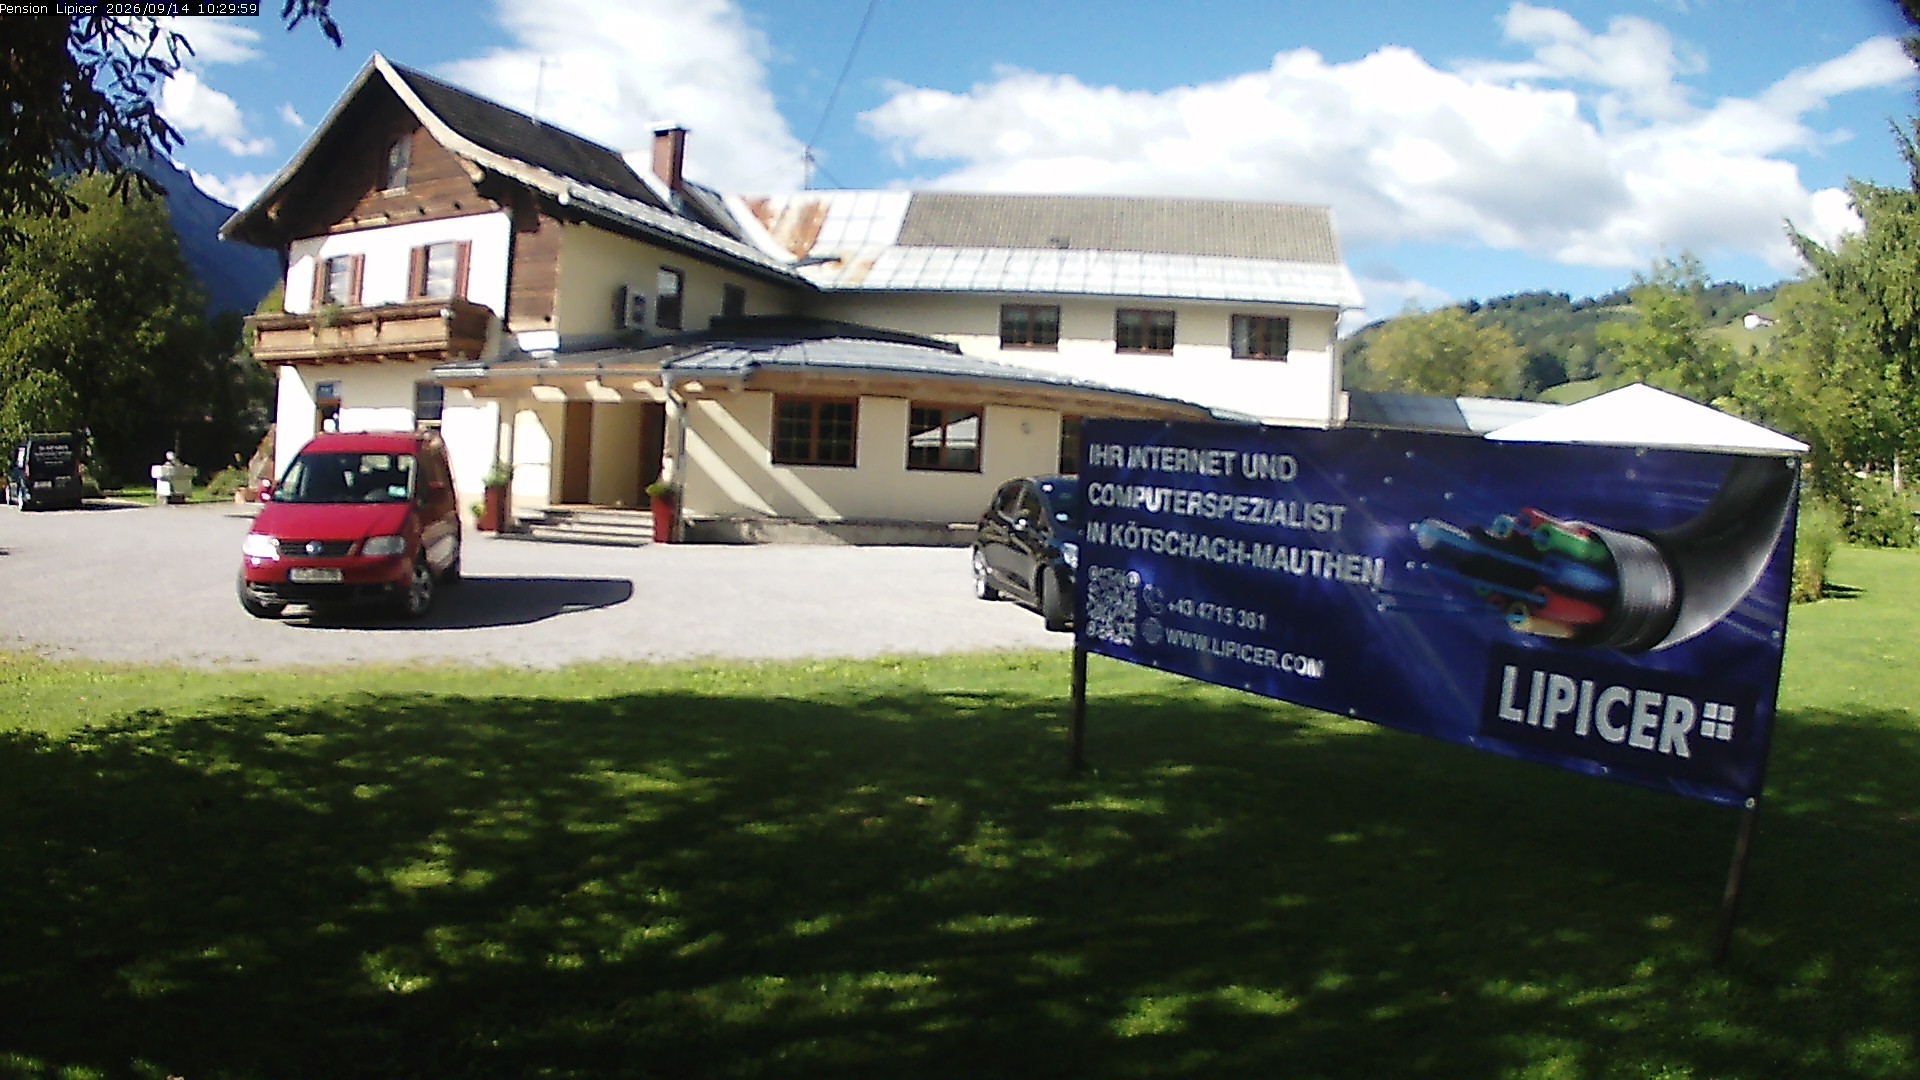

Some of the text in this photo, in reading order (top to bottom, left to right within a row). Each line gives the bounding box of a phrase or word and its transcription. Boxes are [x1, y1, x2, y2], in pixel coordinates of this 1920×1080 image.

[1089, 443, 1299, 483] IHR INTERNET UND
[1088, 482, 1347, 532] COMPUTERSPEZIALIST
[1086, 521, 1386, 586] IN KÖTSCHACH-MAUTHEN
[1167, 598, 1192, 617] +43
[1165, 628, 1327, 679] WWW.LIPICER.COM
[1498, 665, 1697, 758] LIPICER
